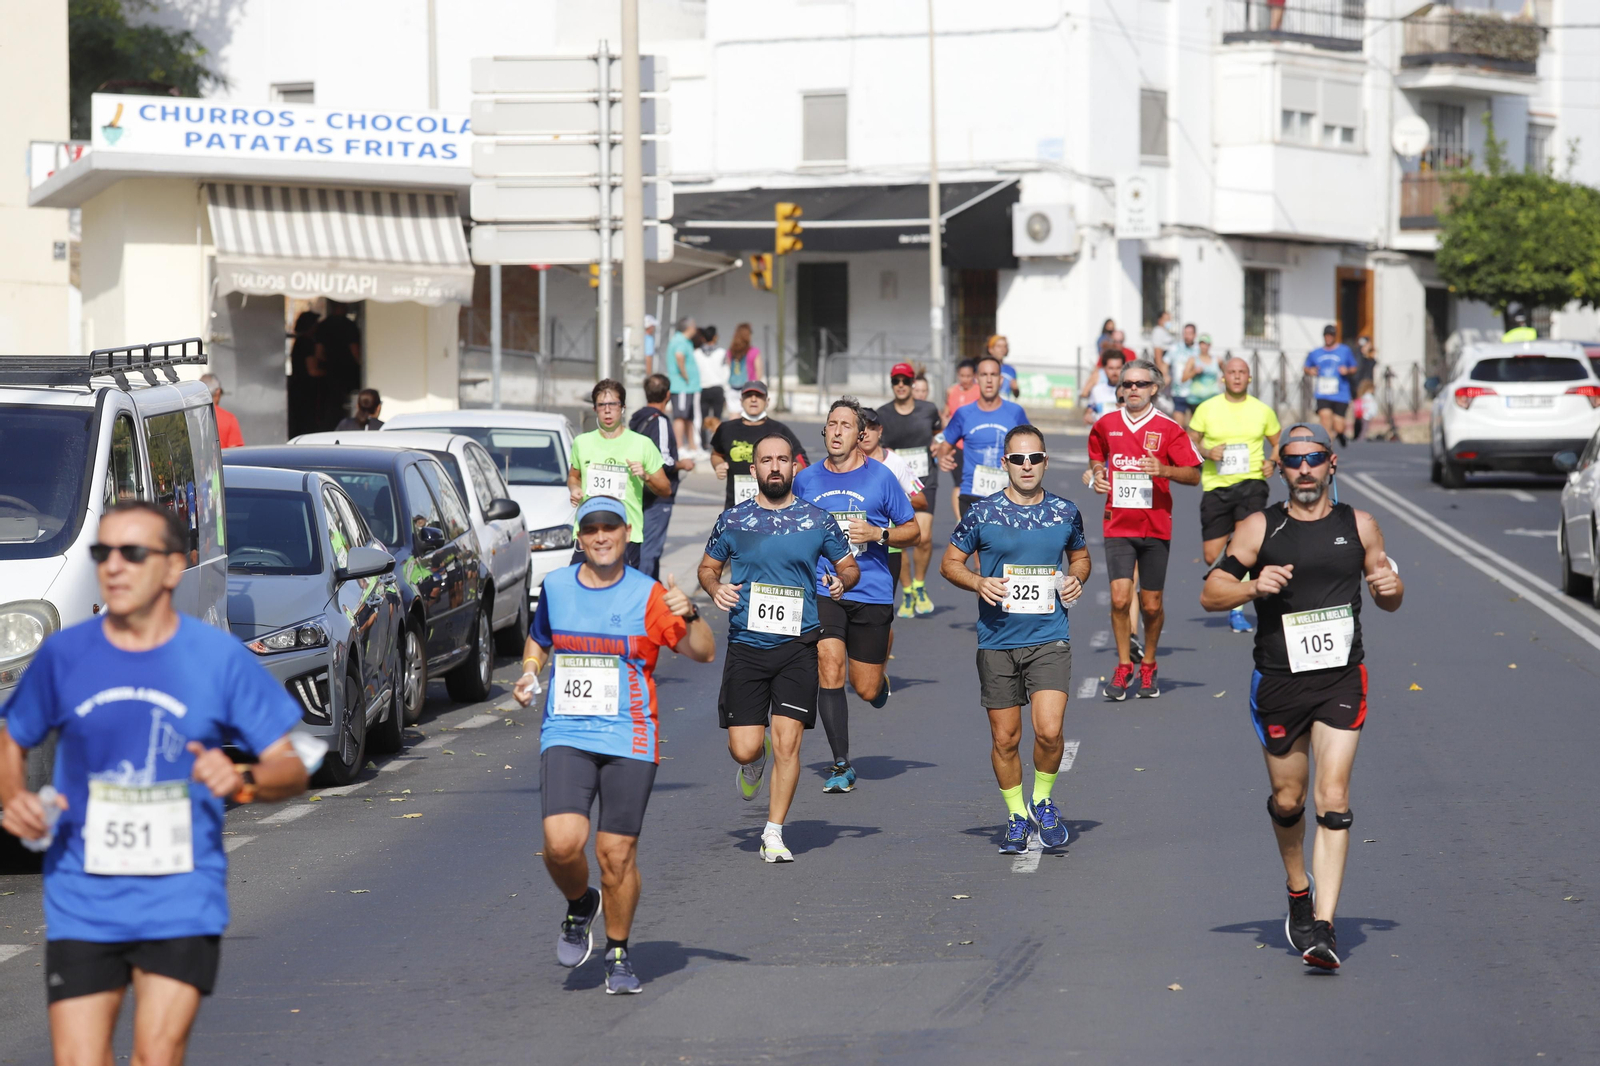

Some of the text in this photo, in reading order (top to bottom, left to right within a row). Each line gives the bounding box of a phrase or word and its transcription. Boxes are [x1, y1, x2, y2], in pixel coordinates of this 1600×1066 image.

[139, 104, 295, 128] CHURROS
[326, 112, 471, 134] CHOCOLA
[185, 131, 458, 160] PATATAS FRITAS
[231, 271, 378, 295] TOLDOS ONUTAPI
[593, 476, 611, 489] 331
[980, 478, 997, 490] 310
[1118, 486, 1137, 498] 397
[761, 586, 779, 595] VUELTA
[784, 589, 801, 597] HUELVA
[1012, 584, 1040, 601] 325
[758, 603, 785, 621] 616
[1296, 613, 1319, 624] VUELTA
[1320, 612, 1326, 620] A
[1326, 608, 1349, 619] HUELVA
[1300, 633, 1334, 654] 105
[565, 657, 584, 667] VUELTA
[590, 658, 614, 667] HUELVA
[563, 679, 593, 698] 482
[104, 821, 152, 849] 551
